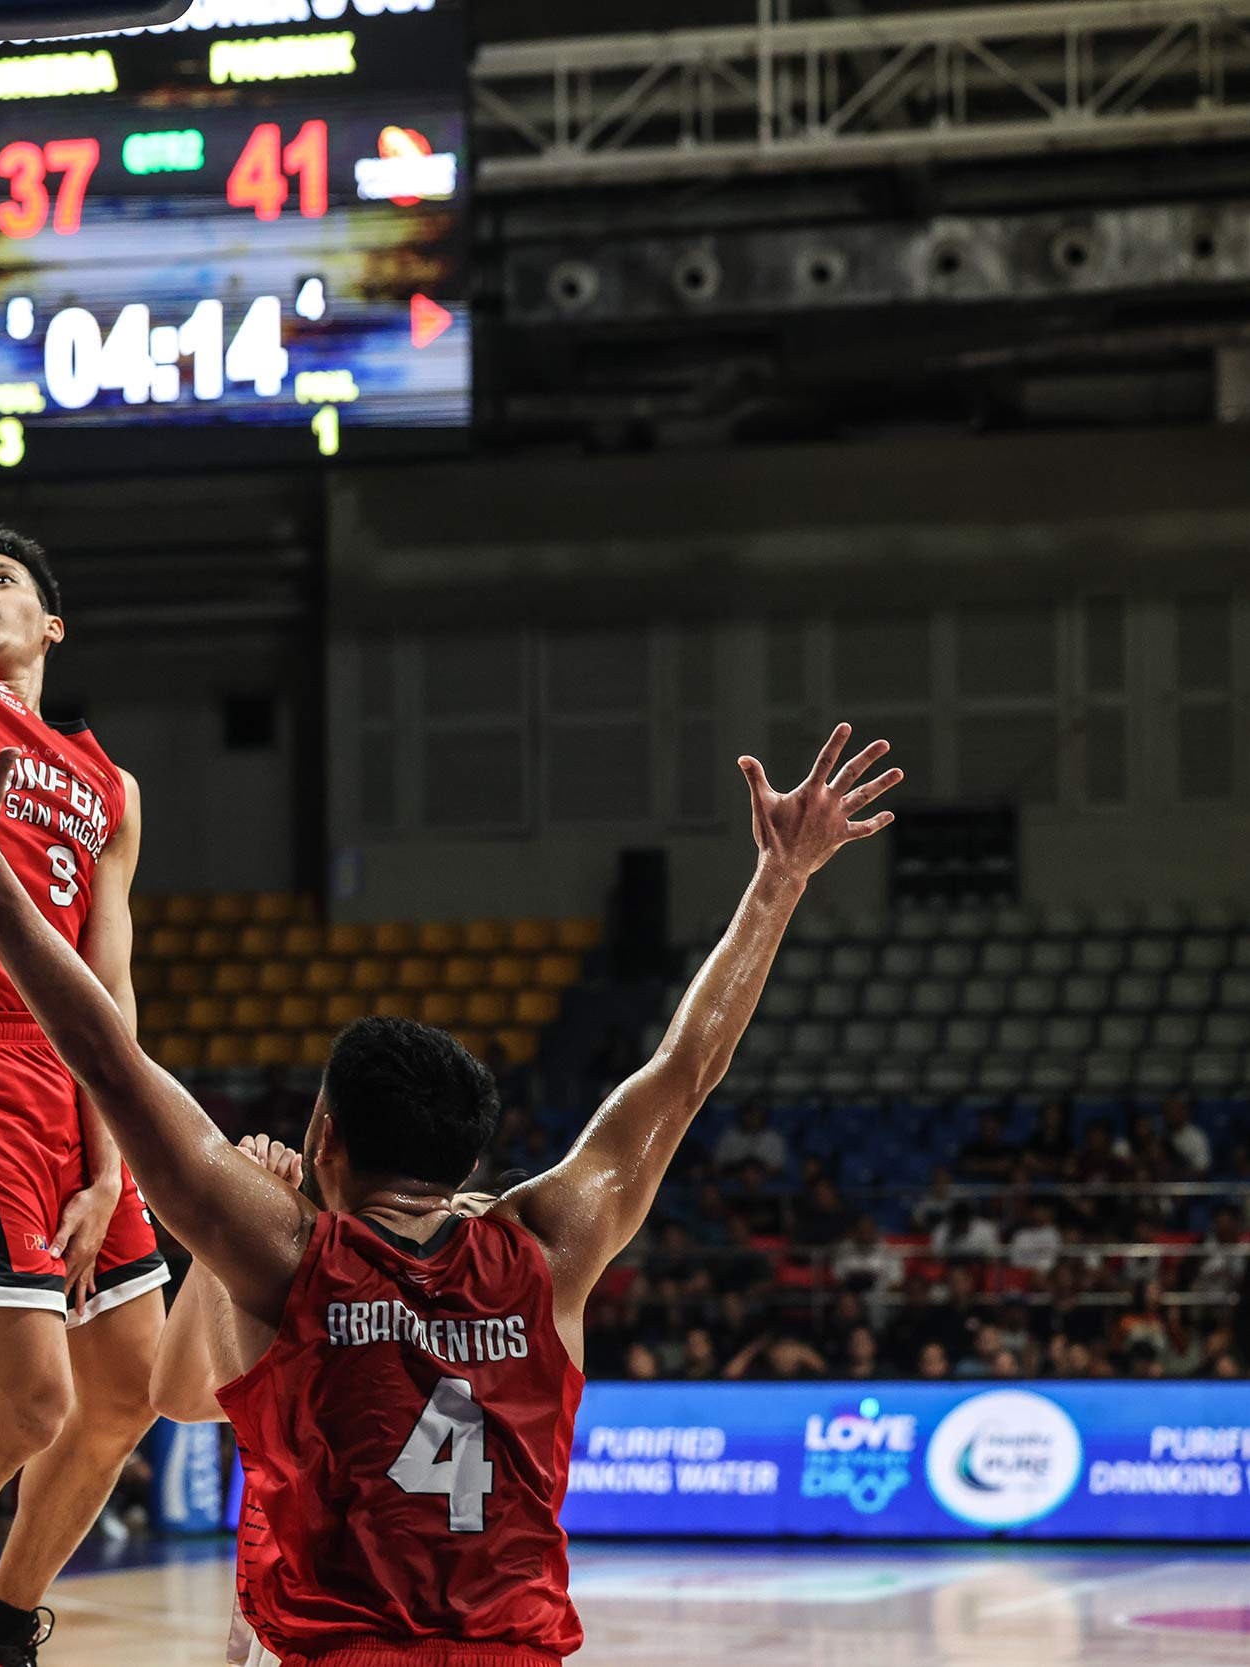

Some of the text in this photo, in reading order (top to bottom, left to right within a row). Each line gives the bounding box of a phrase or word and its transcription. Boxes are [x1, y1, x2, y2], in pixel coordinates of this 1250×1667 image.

[227, 120, 328, 220] 41
[44, 296, 288, 409] 04:14
[311, 405, 340, 455] 1
[5, 794, 52, 827] SAN
[386, 1376, 494, 1532] 4
[805, 1414, 917, 1451] LOVE
[567, 1461, 673, 1496] INKING
